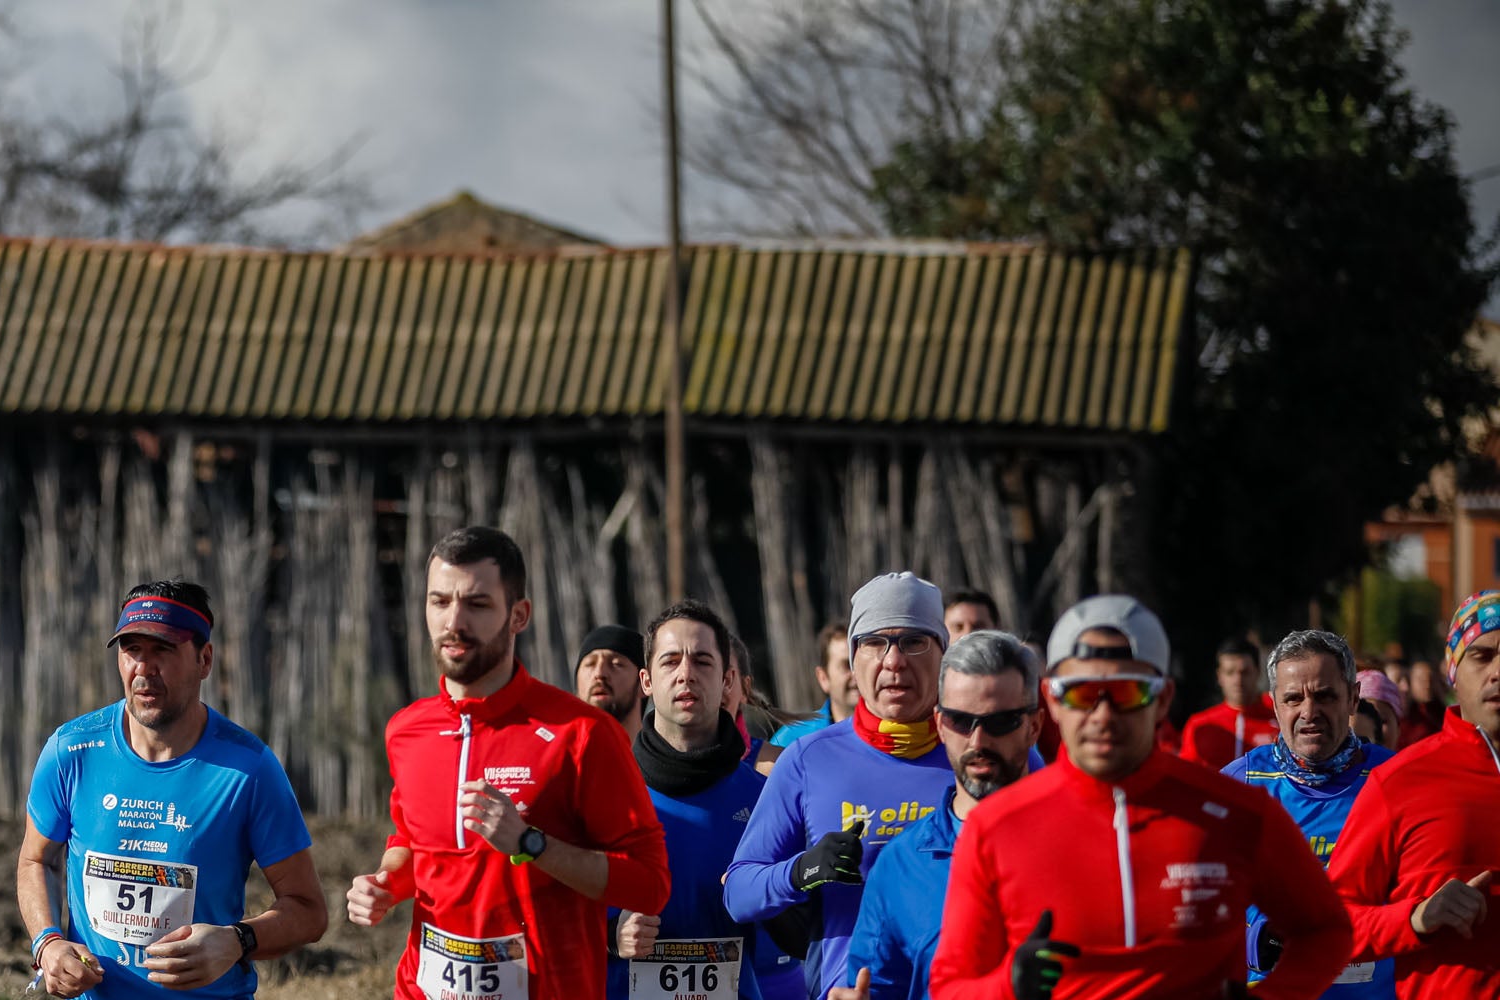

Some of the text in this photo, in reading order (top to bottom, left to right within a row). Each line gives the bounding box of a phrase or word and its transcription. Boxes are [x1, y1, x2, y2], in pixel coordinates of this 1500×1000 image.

[120, 798, 163, 810] ZURICH
[119, 810, 162, 821] MARATÓN
[118, 819, 156, 830] MÁLAGA
[118, 839, 168, 851] 21K MEDIA
[114, 861, 154, 872] CARRERA
[114, 867, 154, 877] POPULAR
[116, 883, 154, 914] 51
[103, 910, 150, 929] GUILLERMO
[151, 917, 163, 929] M.
[445, 937, 480, 950] CARRERA
[442, 961, 500, 993] 415
[659, 964, 718, 992] 616
